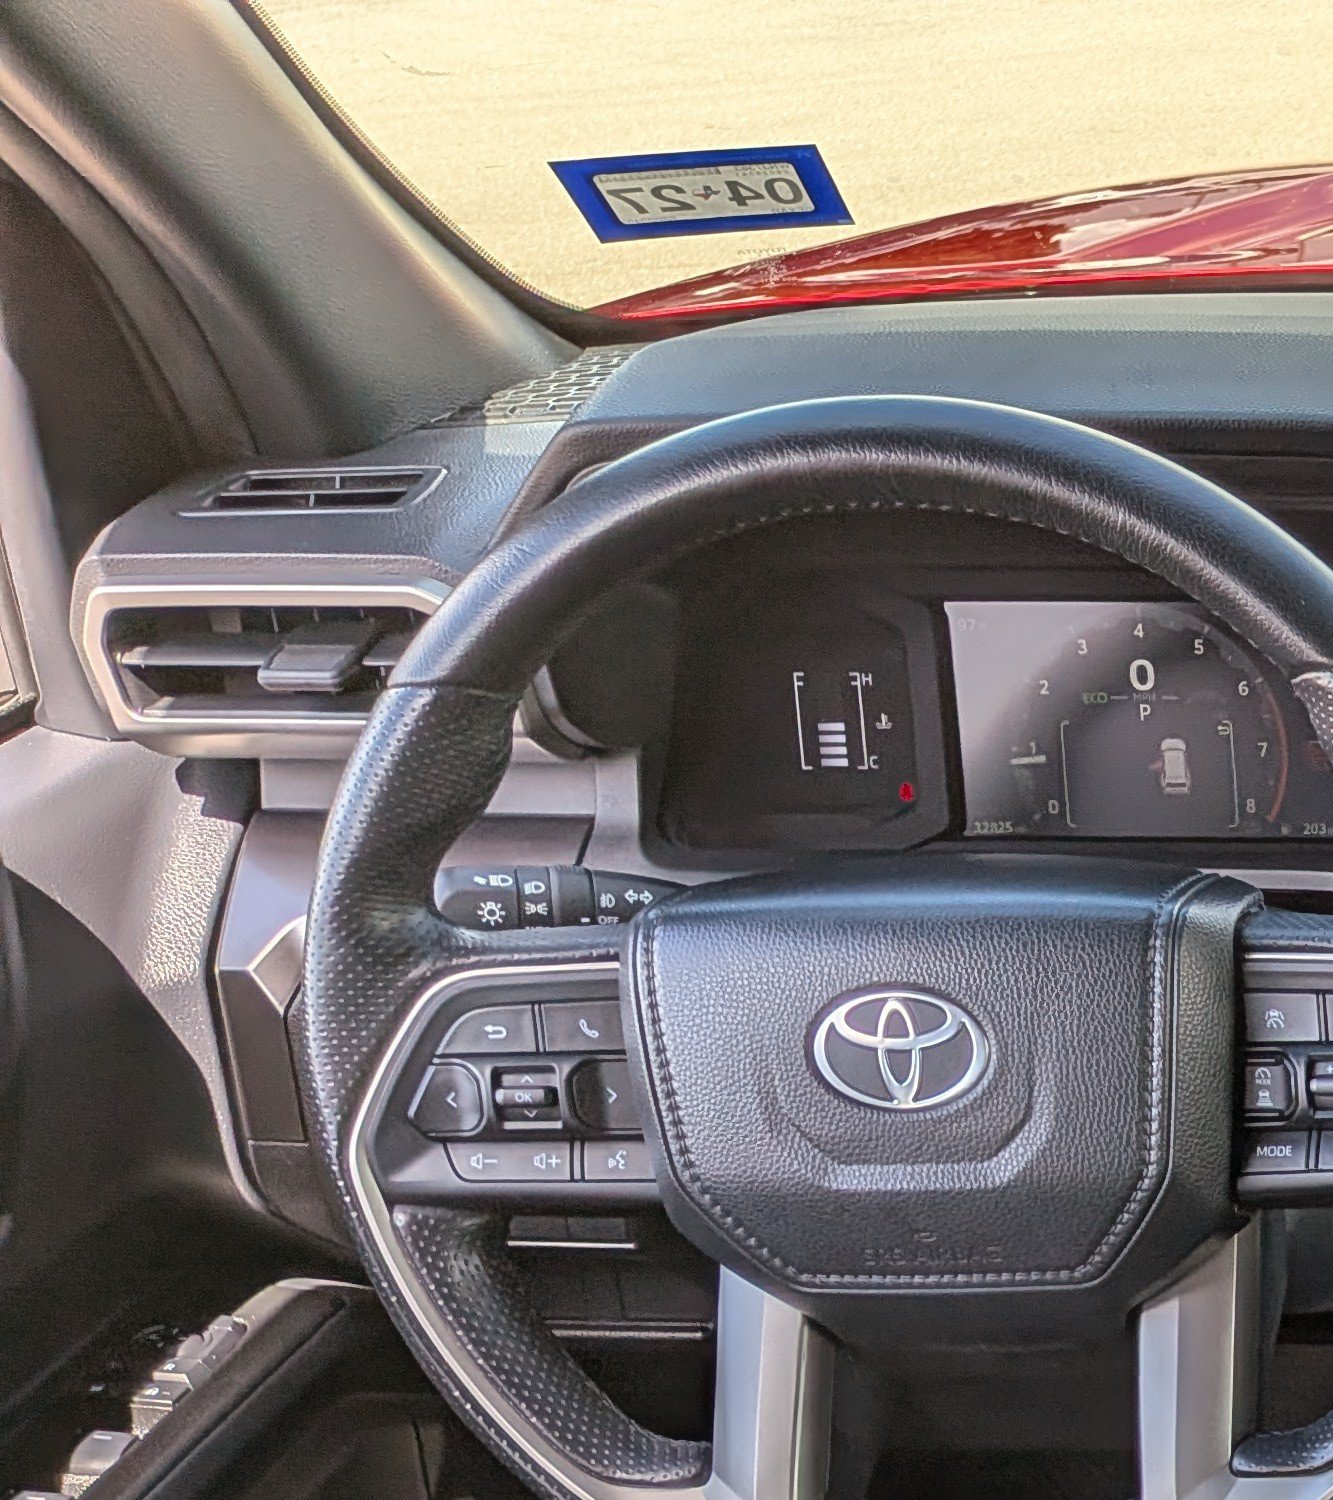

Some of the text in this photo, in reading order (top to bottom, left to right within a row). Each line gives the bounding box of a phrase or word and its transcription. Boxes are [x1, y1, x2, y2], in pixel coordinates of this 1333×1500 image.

[1133, 622, 1144, 638] 4
[1077, 638, 1088, 655] 3
[1193, 638, 1204, 655] 5
[861, 672, 873, 686] H
[1129, 658, 1155, 691] 0
[1038, 679, 1050, 695] 2
[1237, 680, 1249, 696] 6
[1082, 691, 1108, 704] ECO
[1139, 703, 1151, 721] P
[1257, 742, 1268, 758] 7
[869, 755, 879, 770] C
[1048, 799, 1059, 814] 0
[1245, 798, 1256, 814] 8
[598, 915, 619, 925] OFF
[514, 1092, 533, 1103] OK
[1256, 1145, 1293, 1158] MODE
